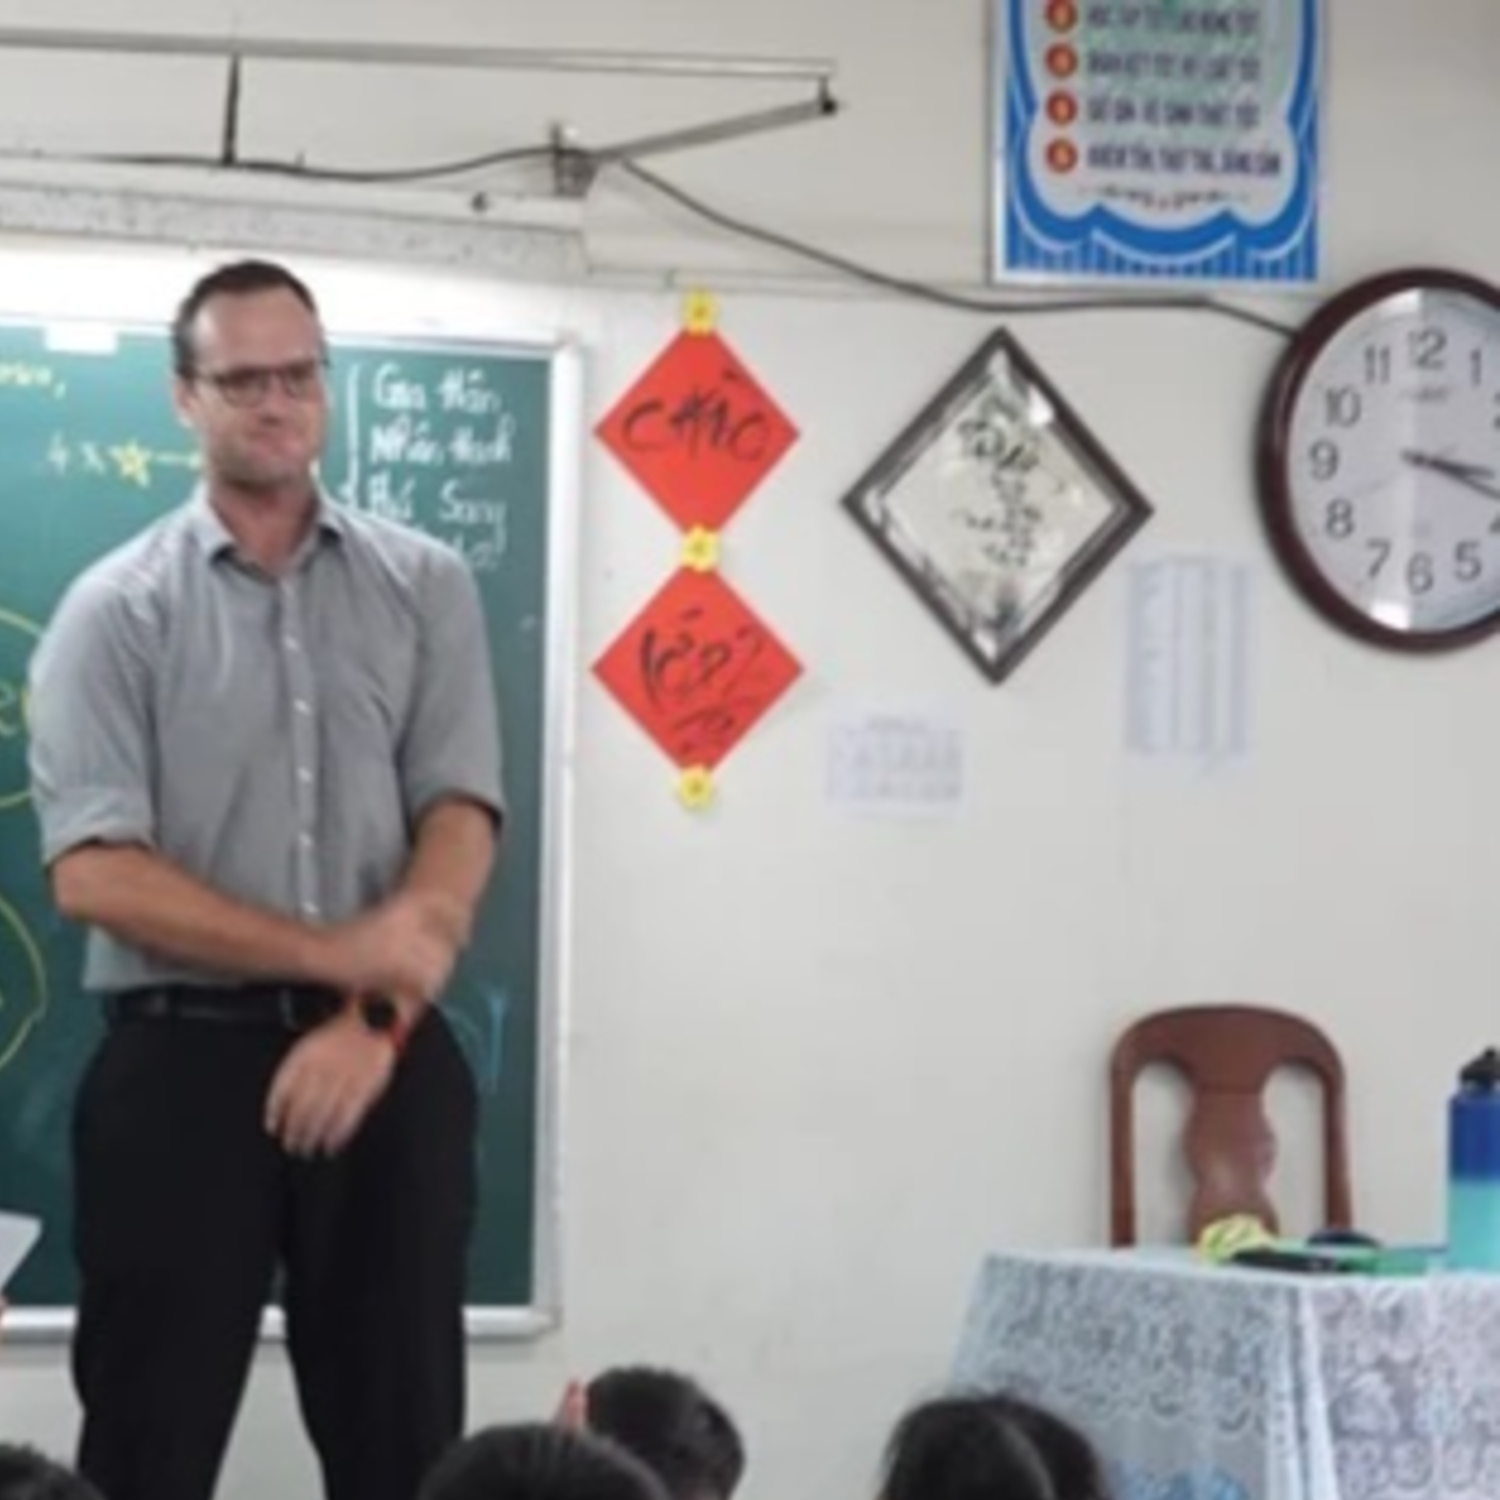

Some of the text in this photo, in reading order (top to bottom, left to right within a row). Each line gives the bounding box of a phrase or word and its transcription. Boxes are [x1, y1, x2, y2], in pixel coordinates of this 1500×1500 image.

[1364, 346, 1393, 385] 11
[1407, 327, 1449, 371] 12
[1466, 347, 1485, 386] 1
[1325, 387, 1363, 427] 10
[1309, 439, 1339, 480] 9
[1325, 498, 1354, 540] 8
[1366, 541, 1392, 579] 7
[1406, 553, 1436, 594] 6
[1454, 541, 1483, 581] 5
